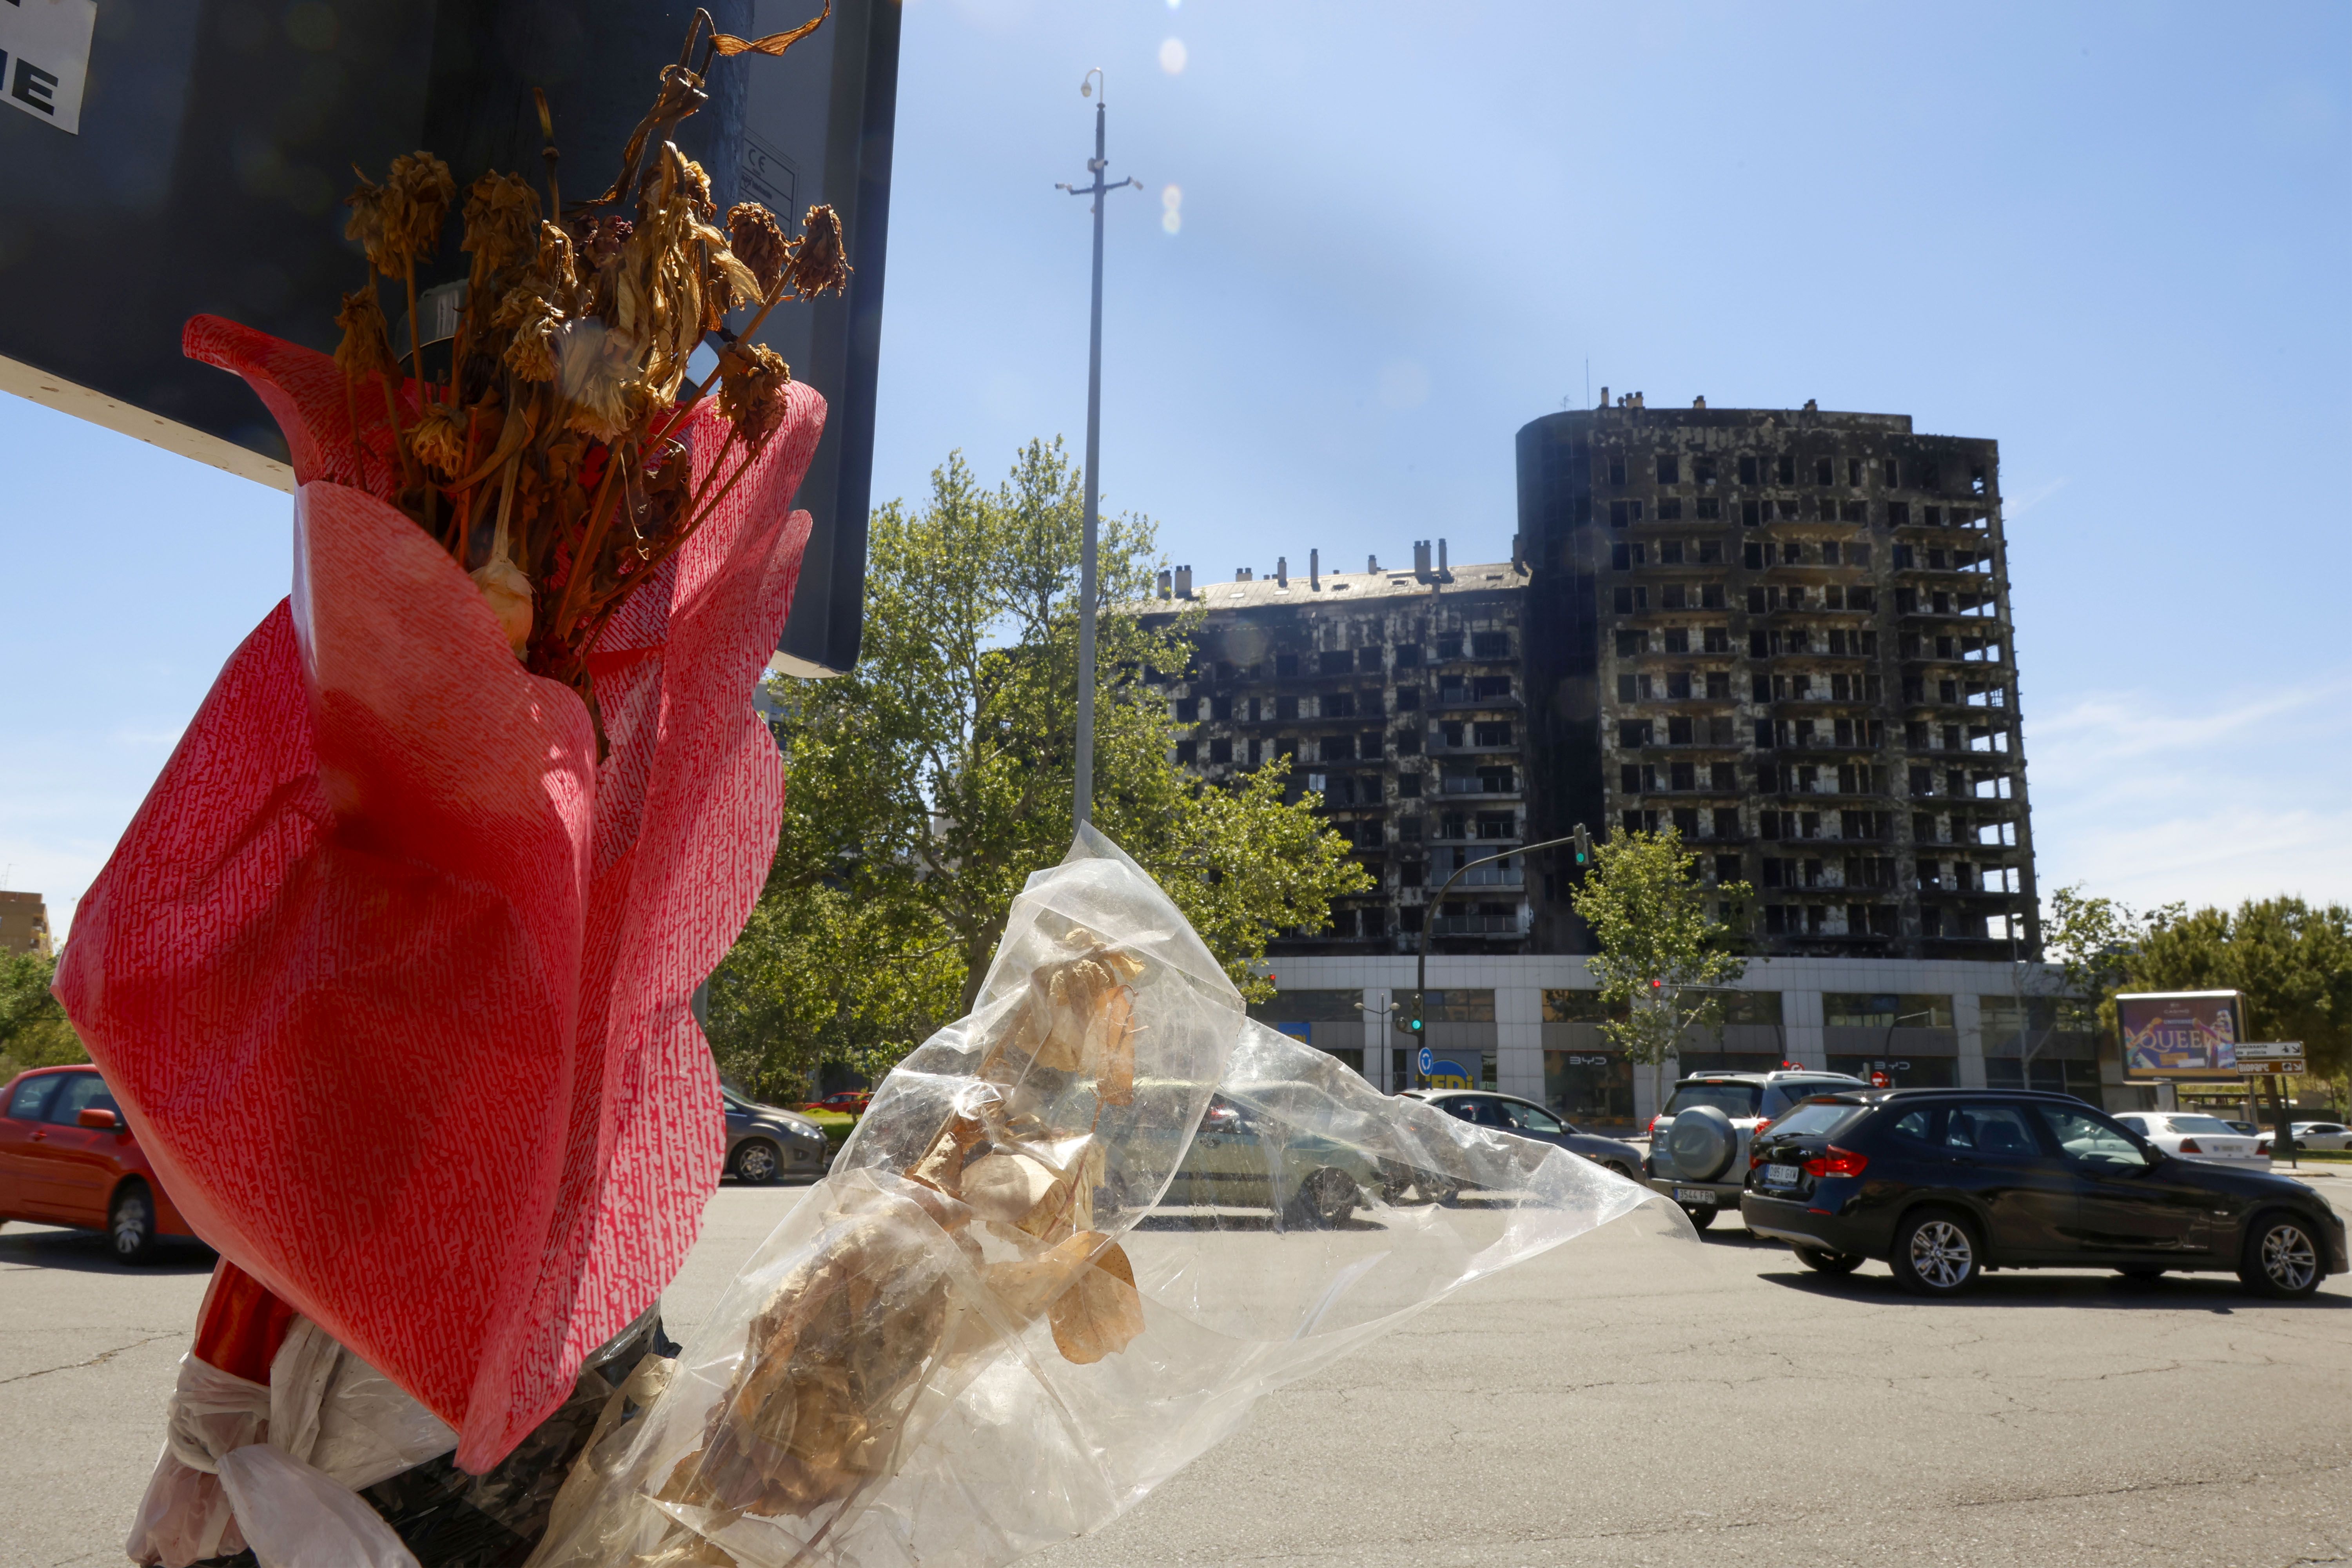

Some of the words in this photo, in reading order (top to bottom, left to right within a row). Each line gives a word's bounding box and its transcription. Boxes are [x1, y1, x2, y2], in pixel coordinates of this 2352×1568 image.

[749, 149, 766, 173] CE
[1570, 1056, 1606, 1065] BYD
[1680, 1190, 1697, 1199] 3544
[1700, 1191, 1714, 1200] FBN
